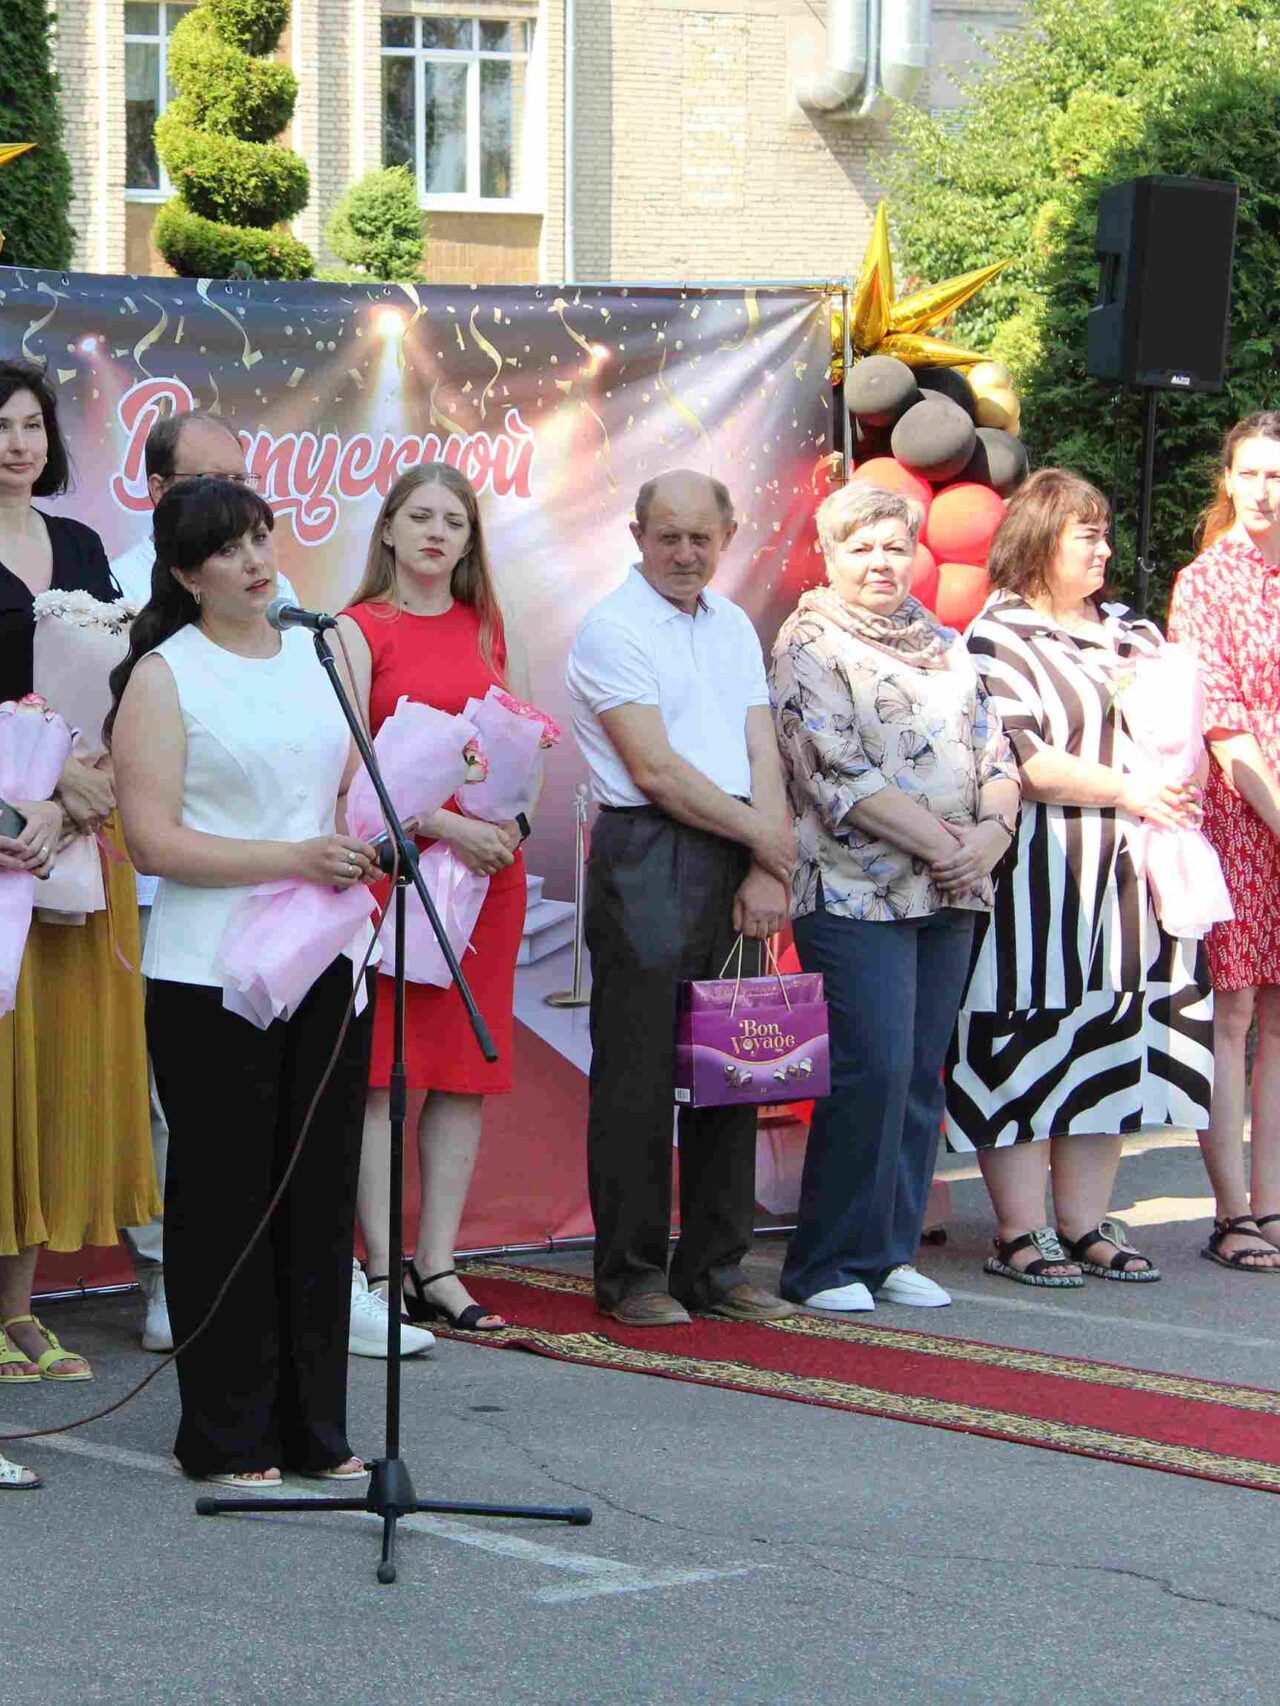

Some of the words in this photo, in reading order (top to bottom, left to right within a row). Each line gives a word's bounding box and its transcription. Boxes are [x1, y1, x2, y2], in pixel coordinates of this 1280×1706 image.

[112, 378, 538, 545] Впуской
[740, 1019, 781, 1038] Bon
[731, 1035, 796, 1057] Voyage
